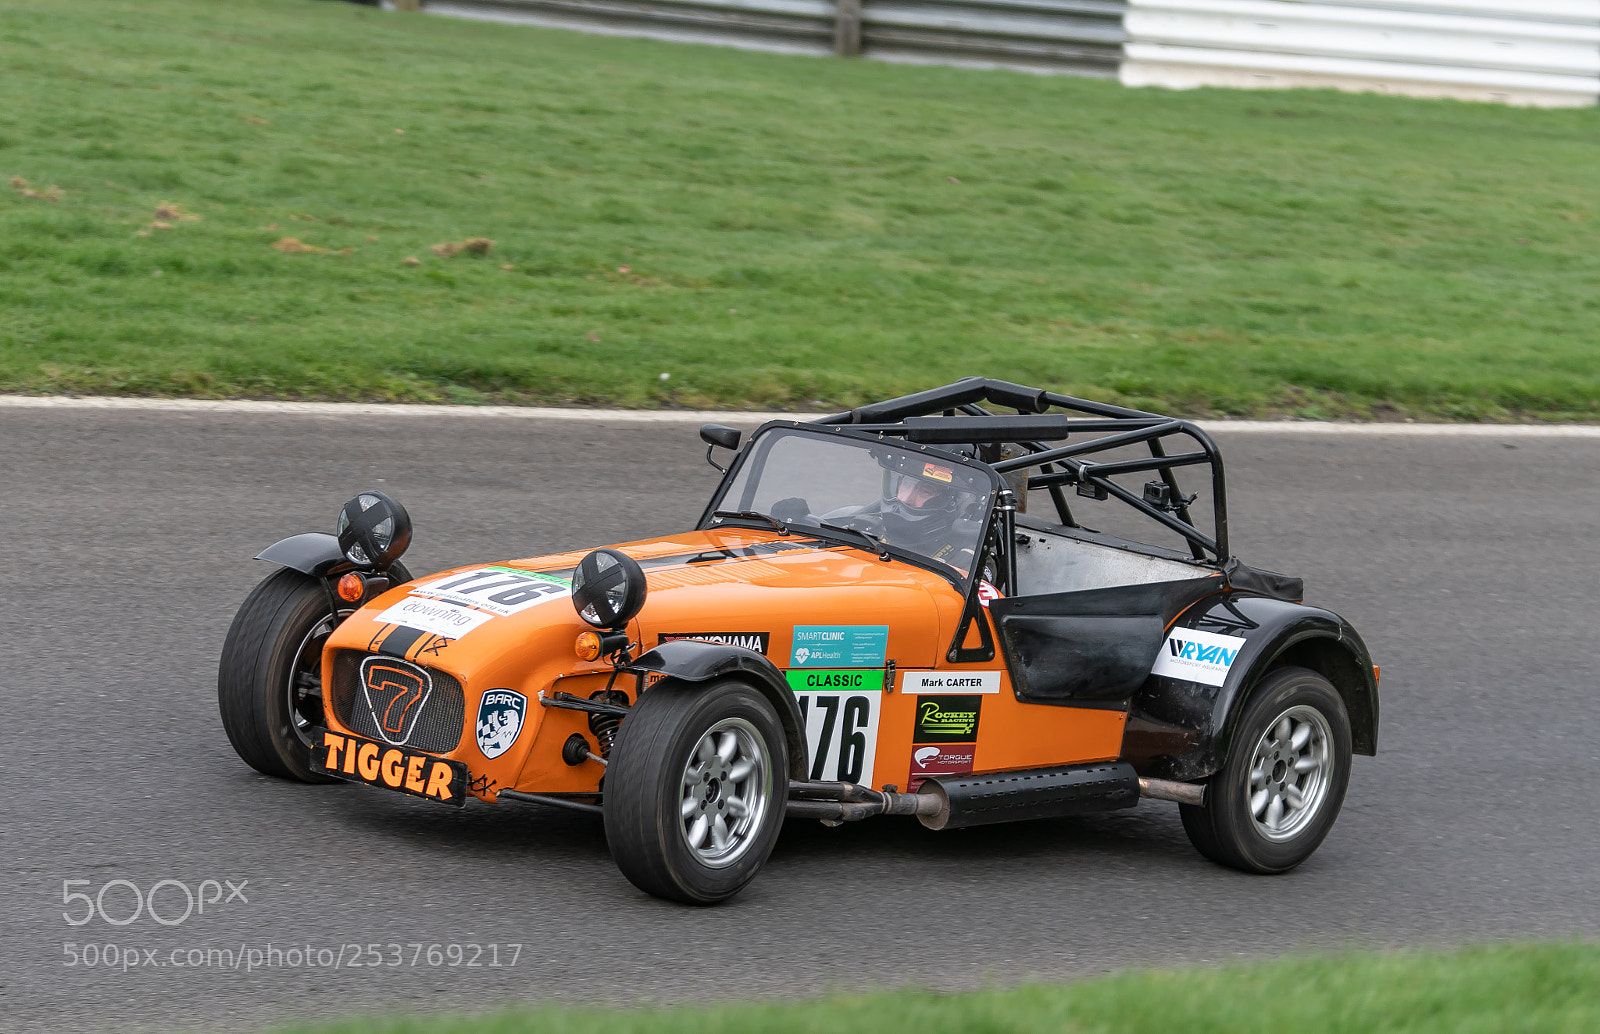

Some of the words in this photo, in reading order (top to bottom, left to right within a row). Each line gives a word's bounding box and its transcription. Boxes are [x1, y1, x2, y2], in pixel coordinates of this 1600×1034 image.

[436, 571, 567, 606] 176
[402, 602, 472, 627] downing
[685, 635, 763, 653] HAMA
[797, 631, 845, 641] SMARTCLINIC
[1170, 658, 1202, 668] MOTORSPORT
[806, 674, 863, 687] CLASSIC
[921, 678, 944, 687] Mark
[946, 678, 982, 687] CARTER
[368, 665, 423, 733] 7
[485, 694, 521, 710] BARC
[798, 695, 870, 785] 76
[324, 732, 453, 801] TIGGER
